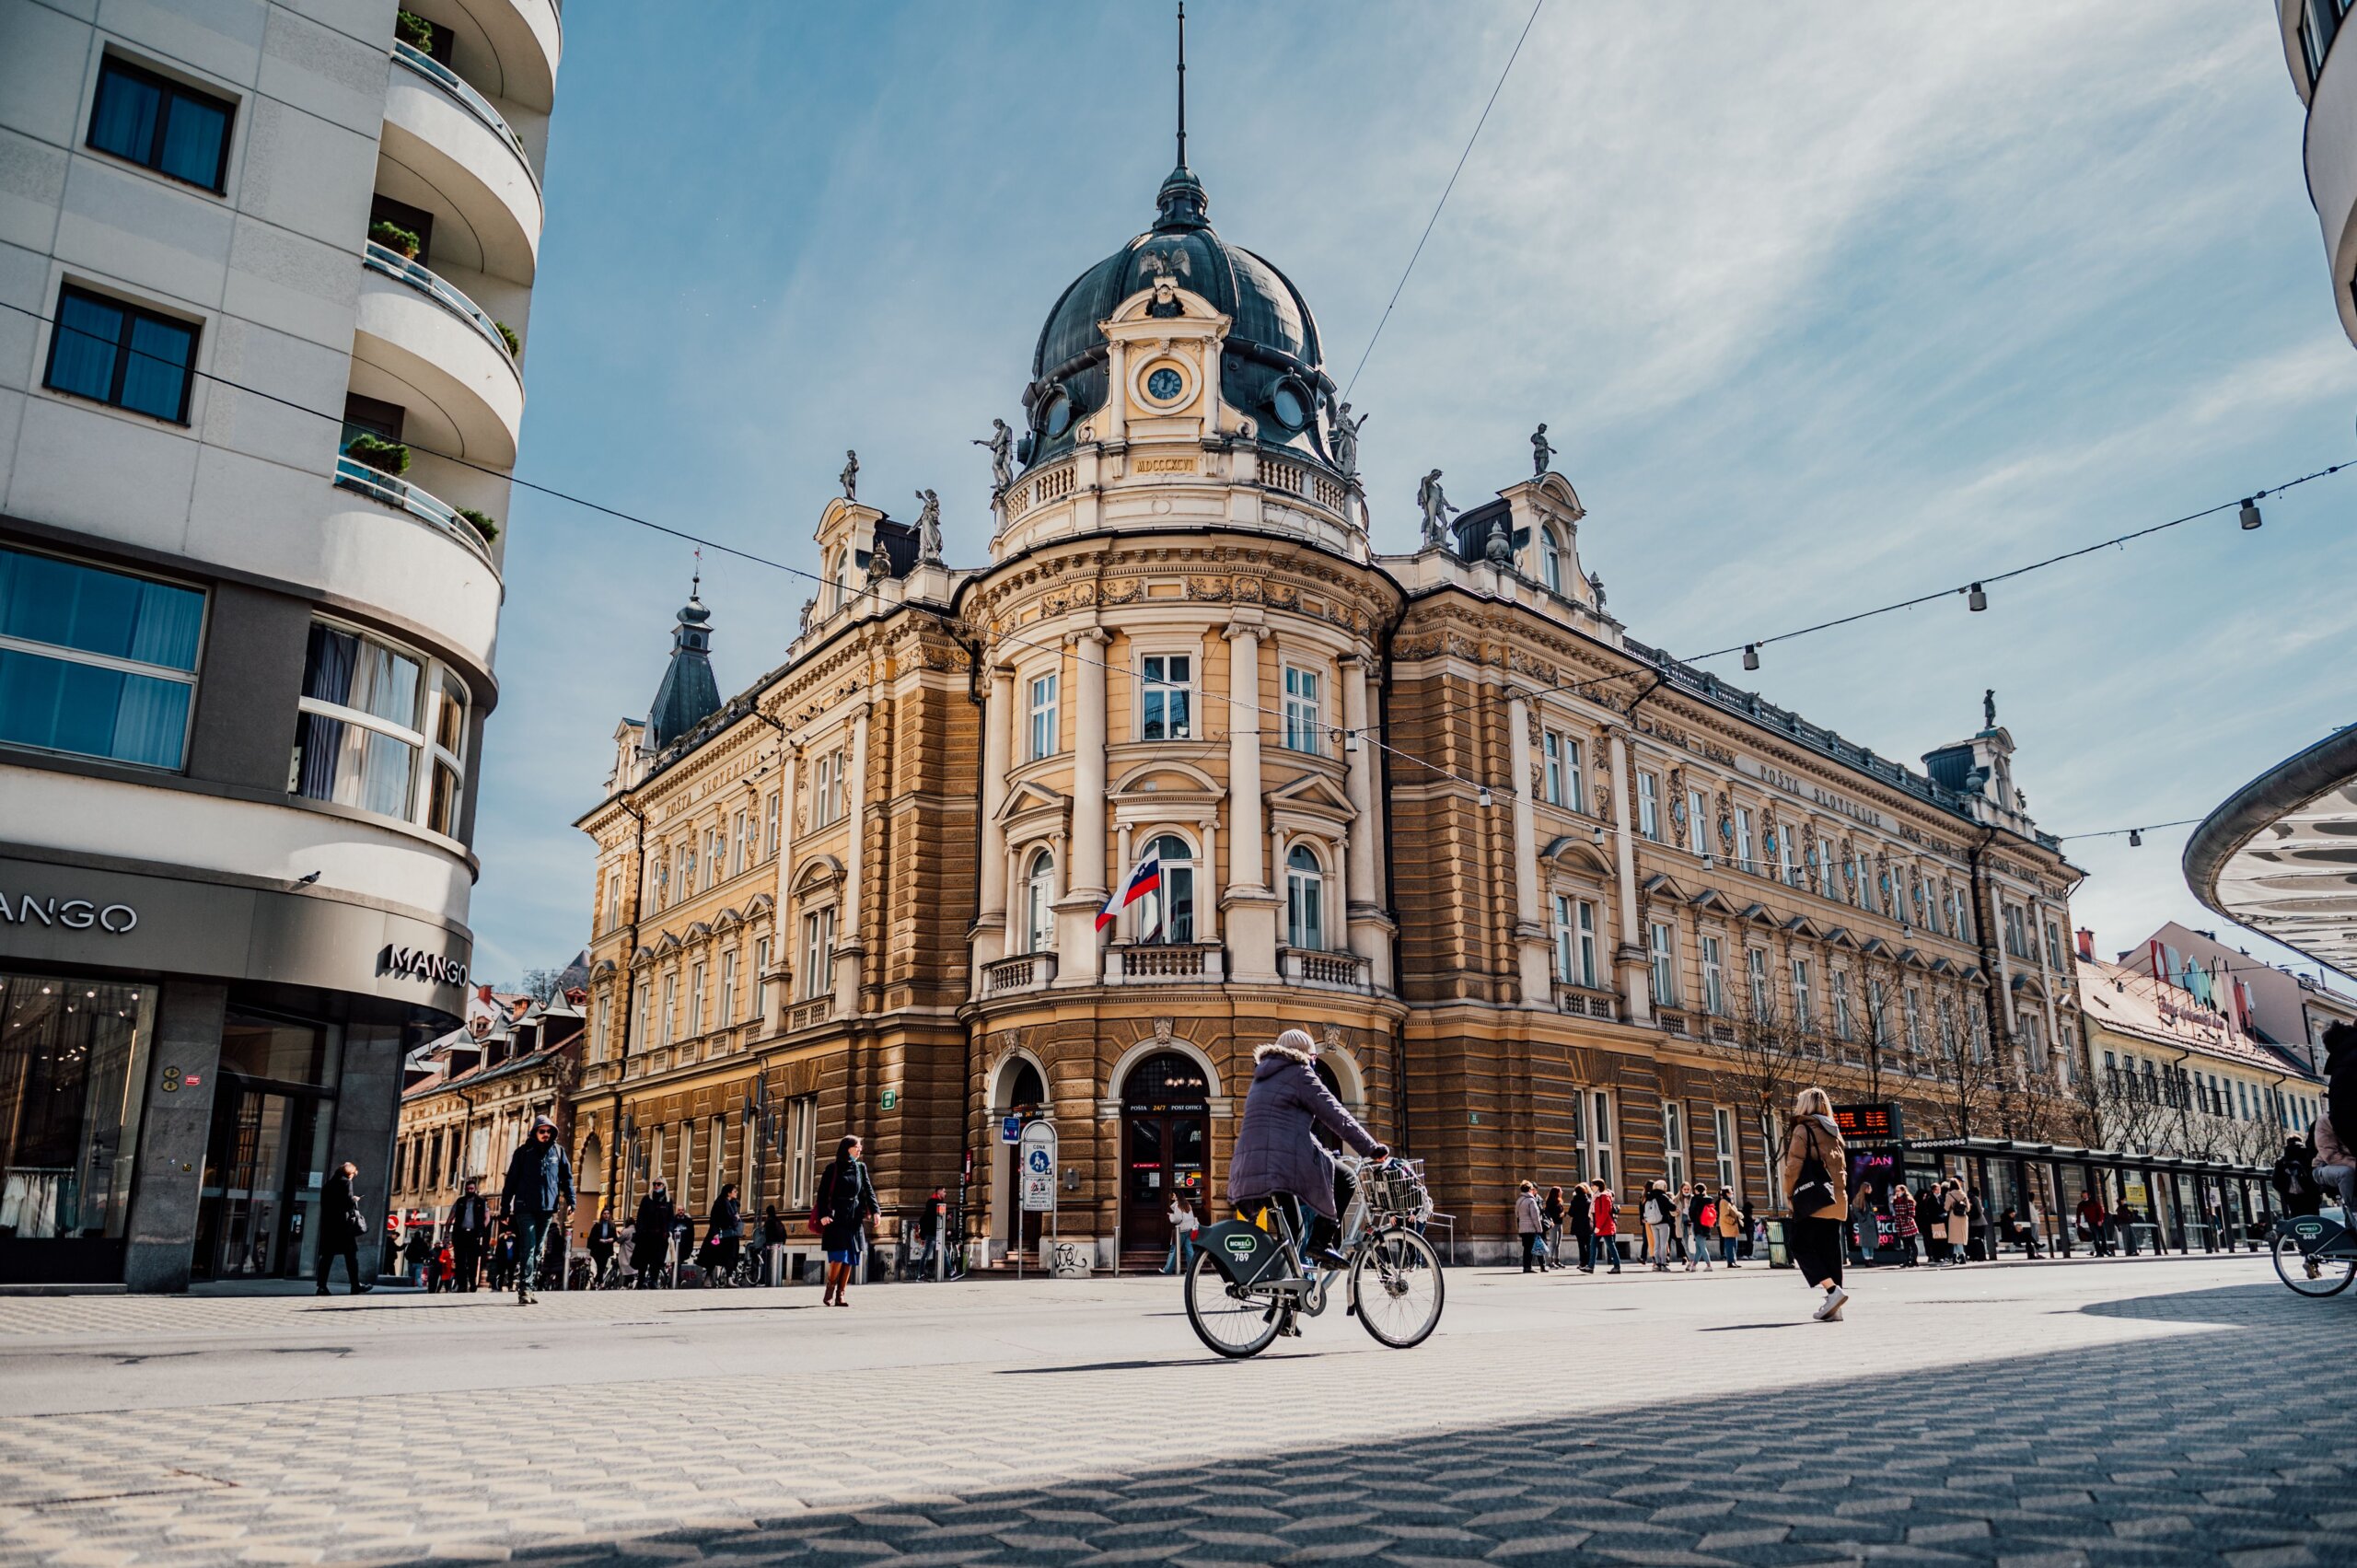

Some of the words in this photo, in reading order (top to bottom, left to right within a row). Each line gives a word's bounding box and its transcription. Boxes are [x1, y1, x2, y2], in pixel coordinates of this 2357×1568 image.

[1136, 459, 1194, 473] MDCCCXCVI
[666, 792, 691, 819] POŠTA
[701, 749, 760, 797] SLOVENIJE
[1759, 764, 1801, 796] POŠTA
[1814, 787, 1881, 828] SLOVENIJE
[389, 944, 468, 988] MANGO
[1869, 1156, 1892, 1166] JAN
[1234, 1253, 1249, 1261] 789
